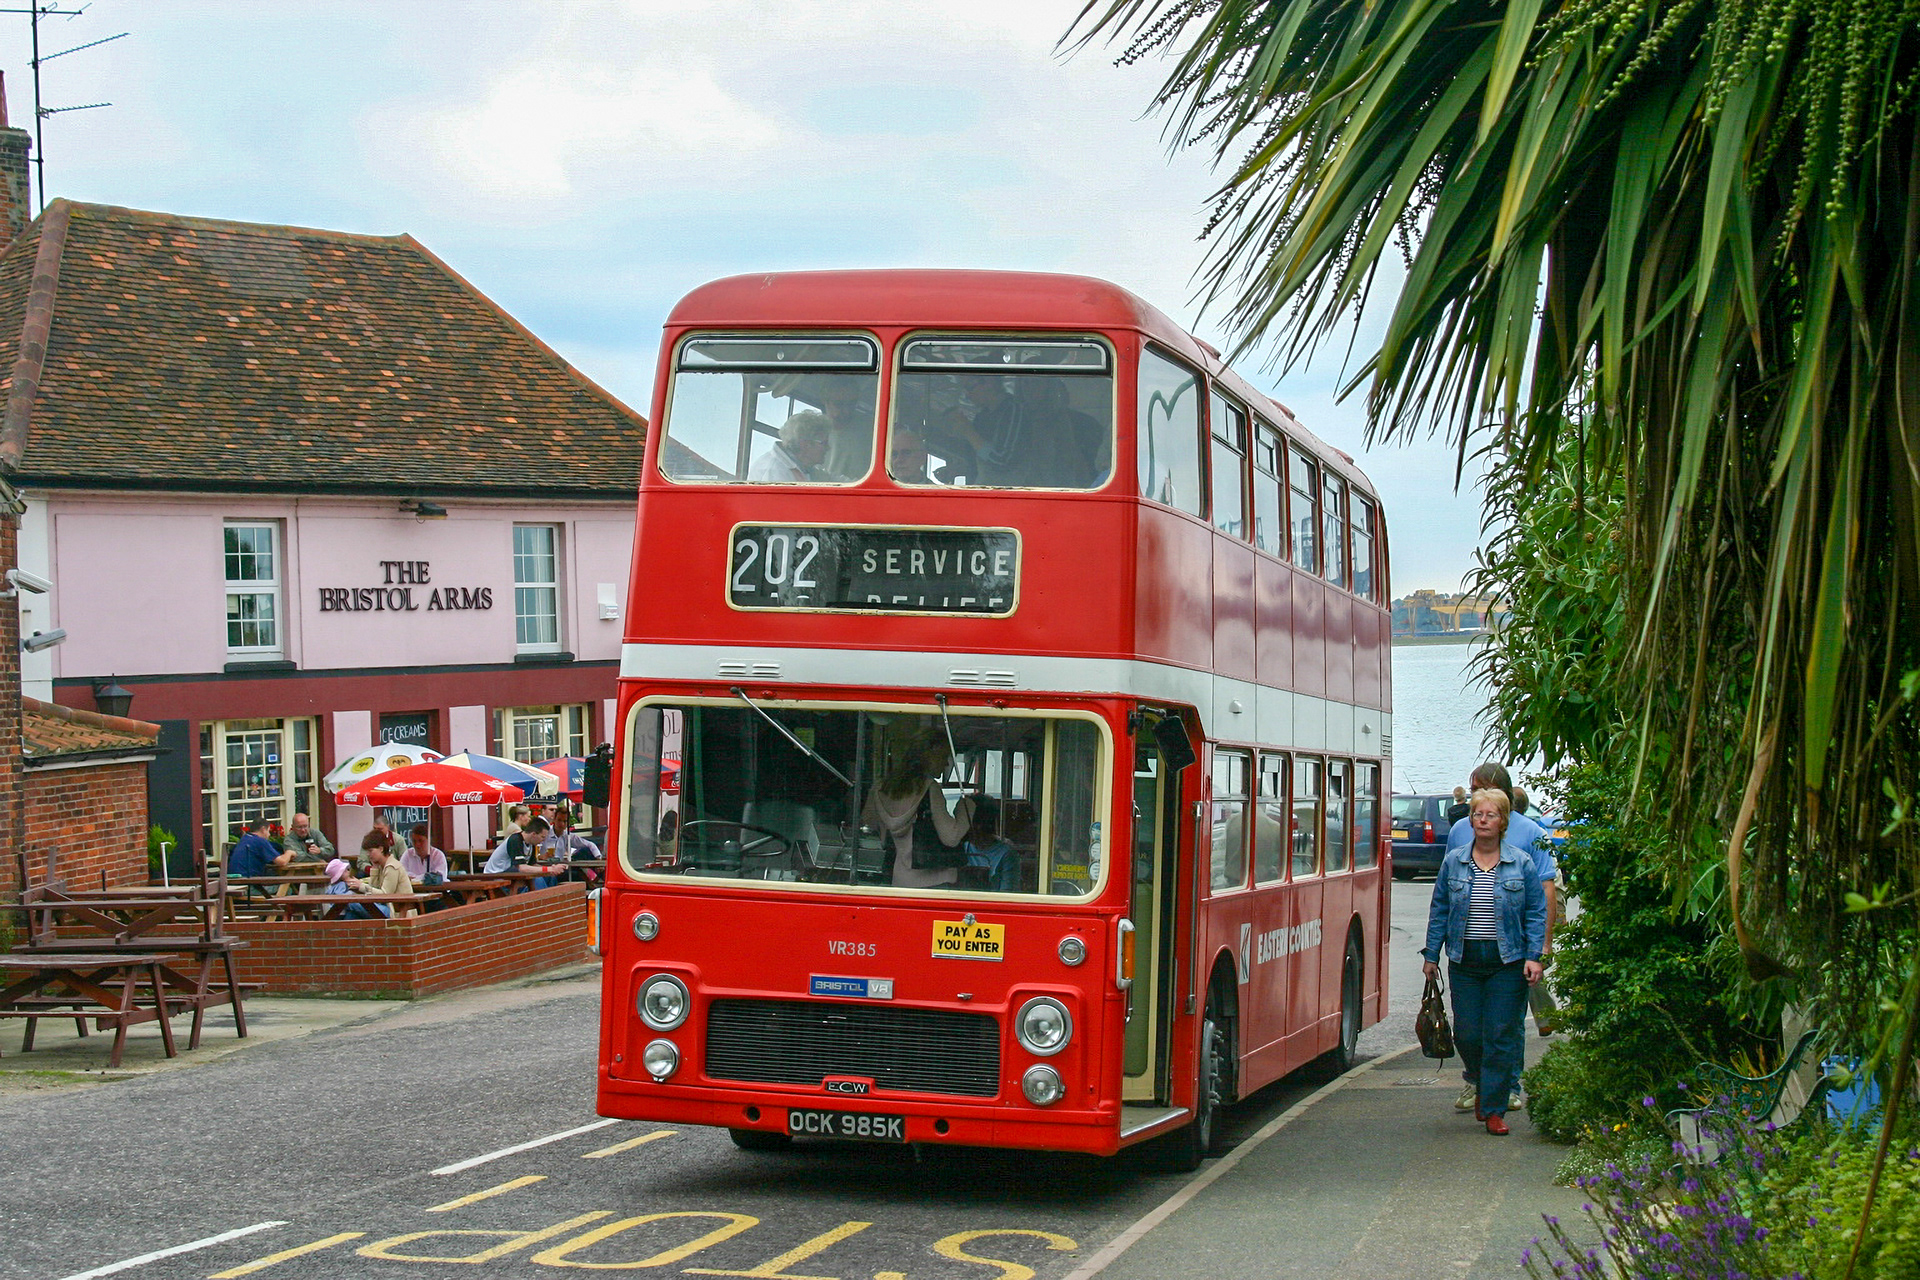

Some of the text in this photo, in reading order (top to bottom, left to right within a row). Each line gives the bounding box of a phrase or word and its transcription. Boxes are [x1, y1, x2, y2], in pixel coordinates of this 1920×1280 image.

[732, 534, 820, 592] 202
[862, 548, 1011, 576] SERVICE
[380, 560, 431, 585] THE
[319, 587, 493, 612] BRISTOL ARMS
[380, 723, 427, 743] ICE CREAMS
[452, 791, 483, 803] Coca-Cola
[945, 926, 990, 939] PAY AS
[1257, 918, 1322, 965] EASTERN COUNTIES
[828, 940, 877, 957] VR385
[938, 939, 999, 953] YOU ENTER
[815, 981, 888, 994] BRISTOL VR
[828, 1082, 866, 1093] ECW
[790, 1111, 902, 1138] OCK 985K
